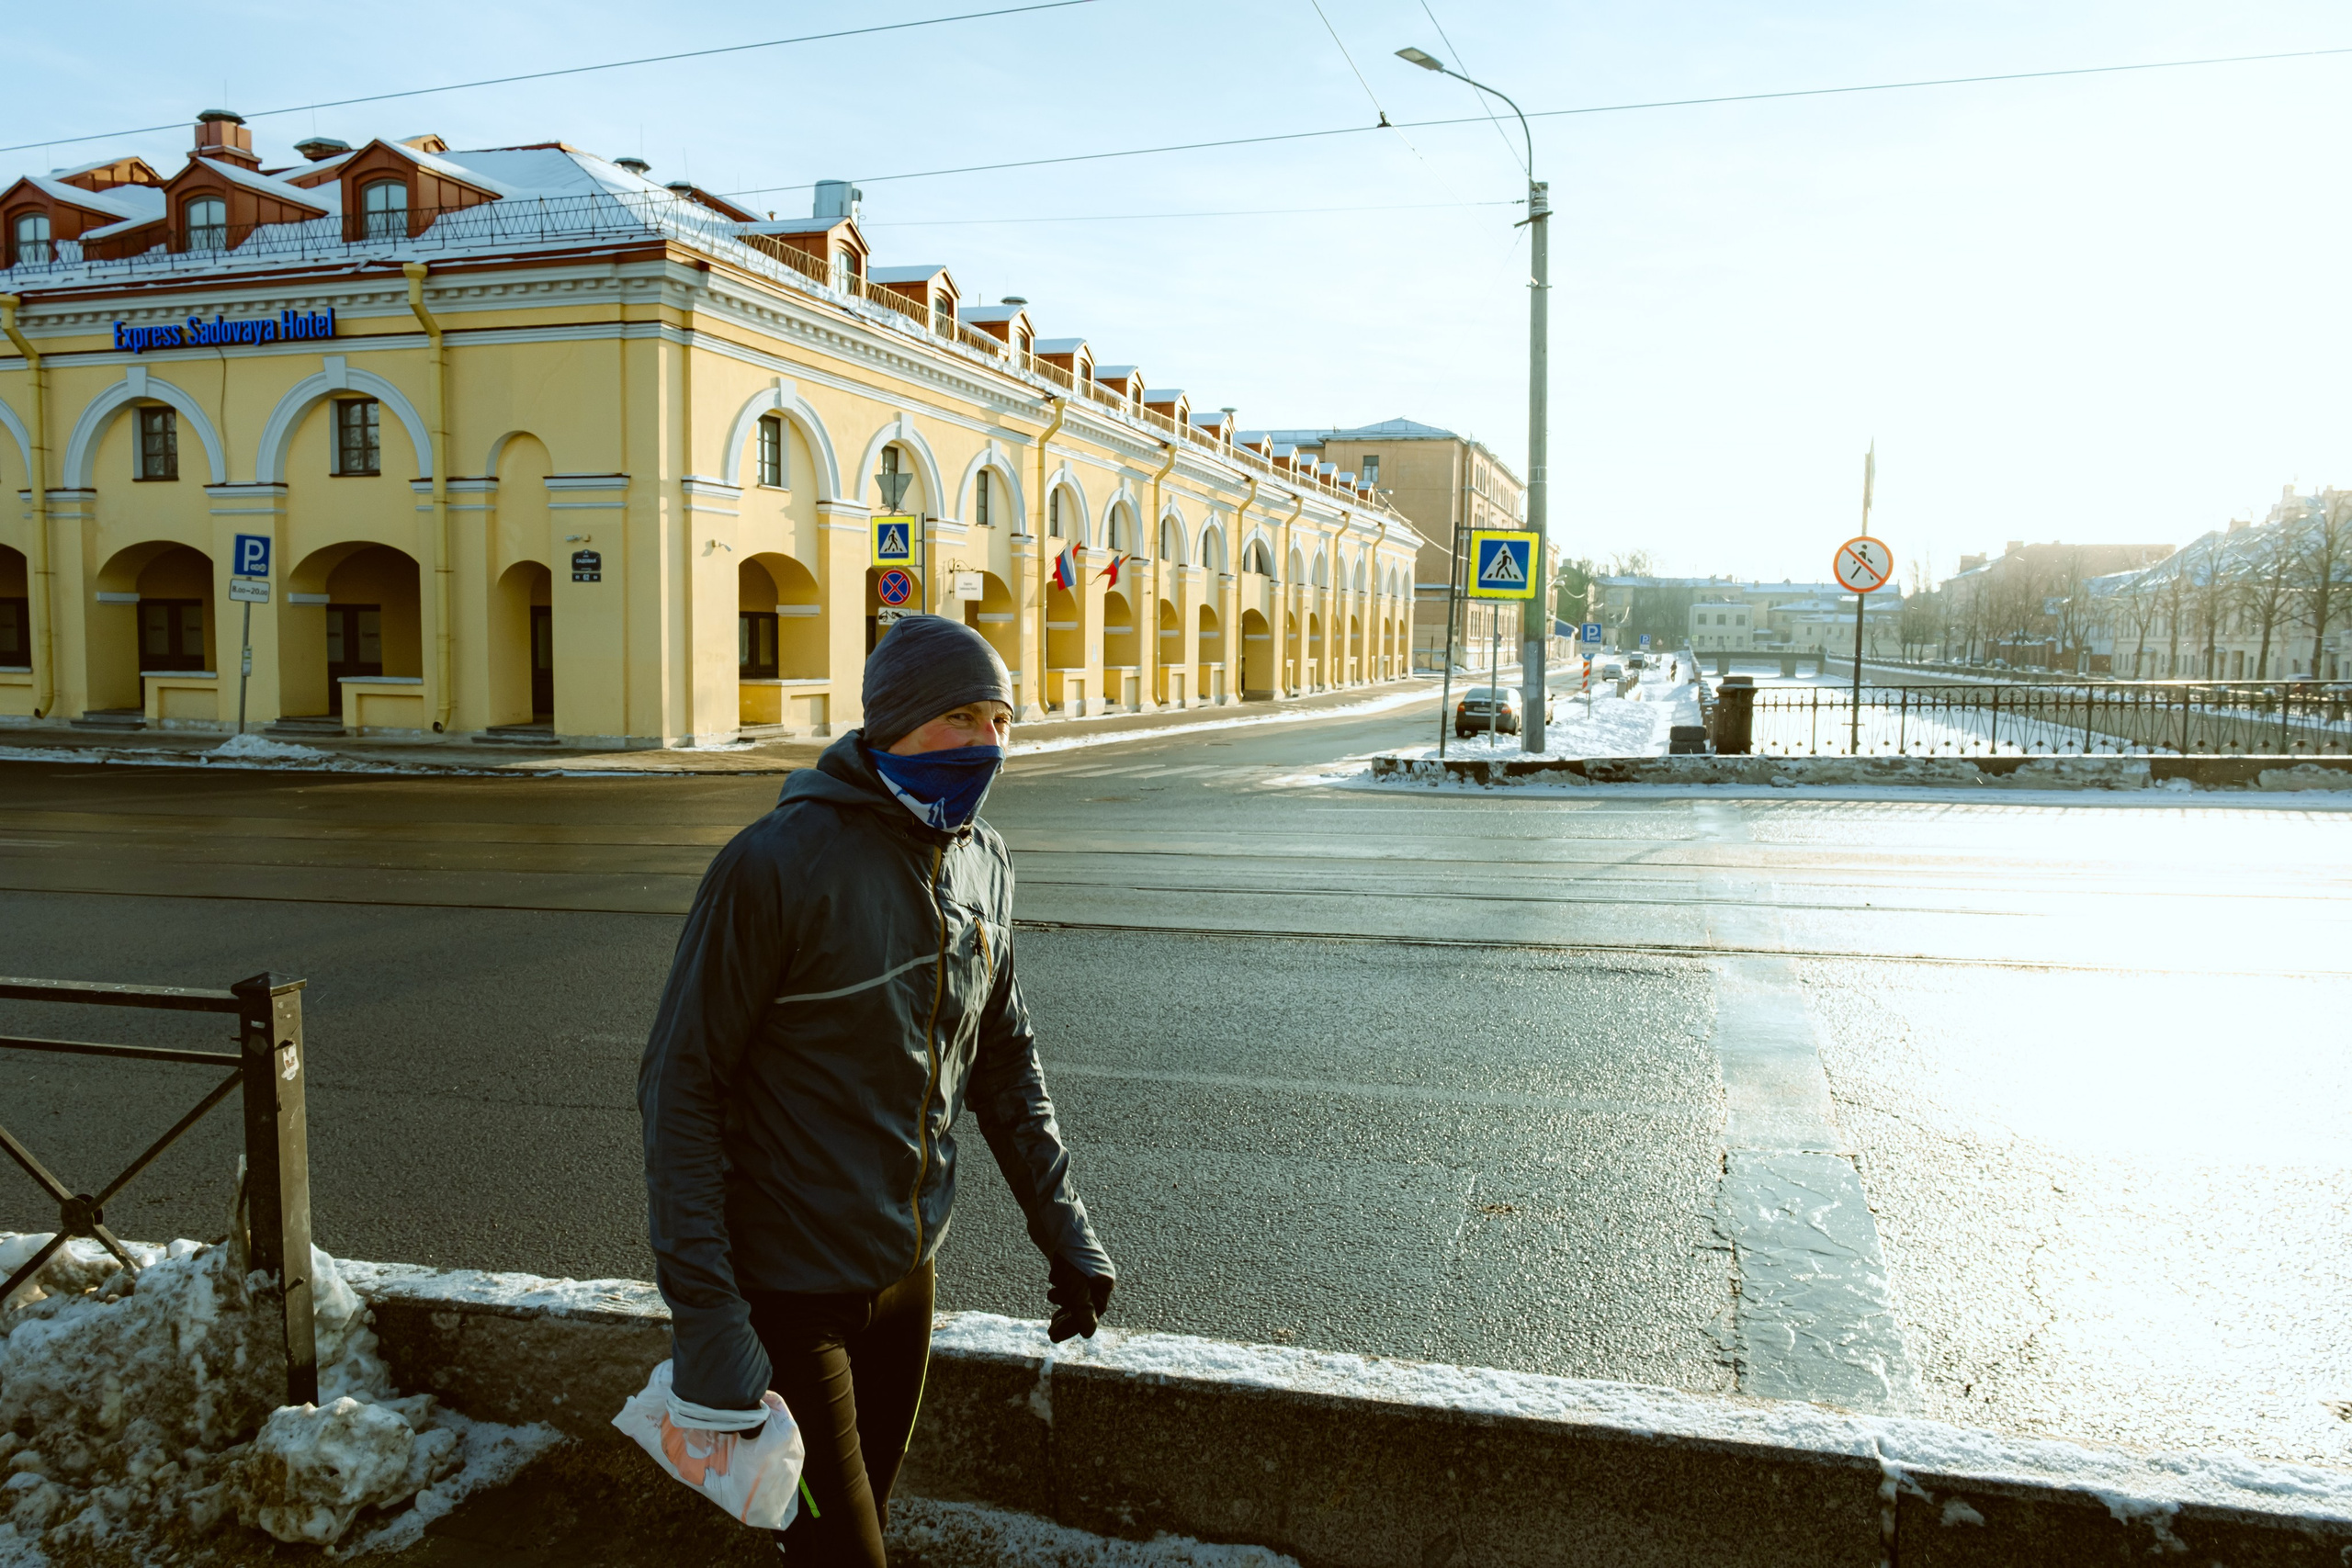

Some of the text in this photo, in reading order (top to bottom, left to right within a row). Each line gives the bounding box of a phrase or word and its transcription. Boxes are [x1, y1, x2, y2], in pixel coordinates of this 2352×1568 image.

[113, 307, 333, 355] Express Sadovaya Hotel
[243, 539, 265, 571] P
[1587, 625, 1599, 641] P
